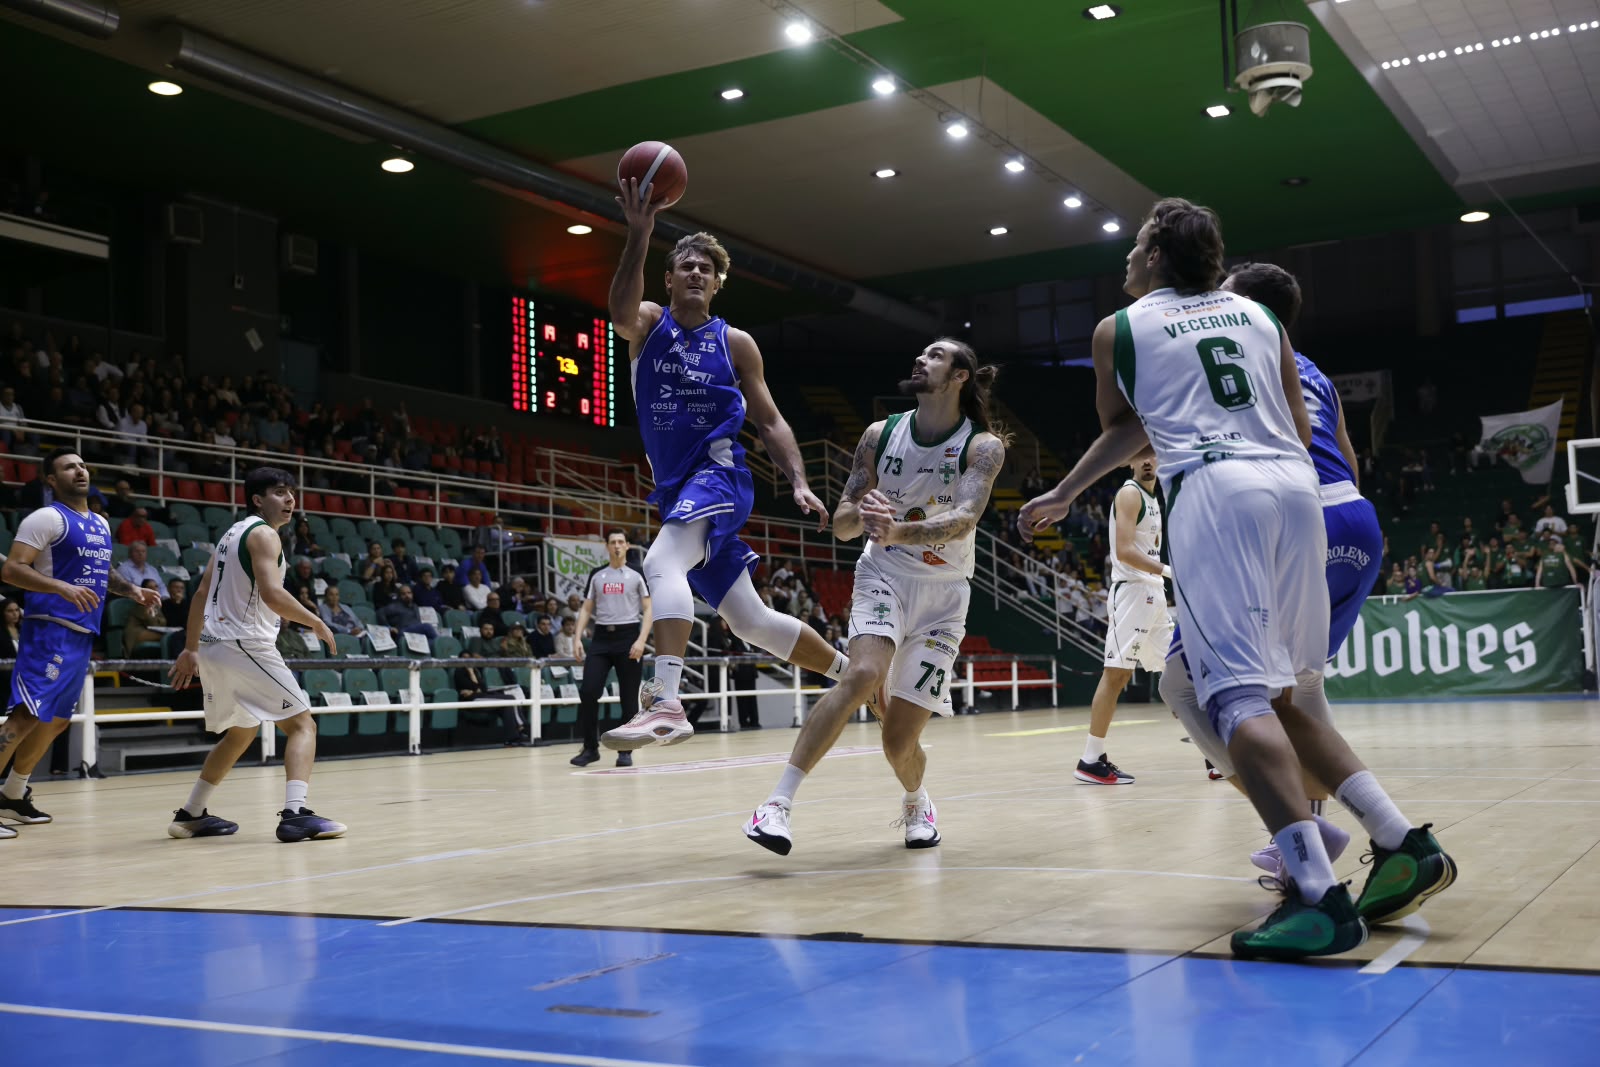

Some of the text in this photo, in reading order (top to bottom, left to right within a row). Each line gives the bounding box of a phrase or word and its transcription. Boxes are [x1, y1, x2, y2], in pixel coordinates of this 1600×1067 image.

[1181, 296, 1234, 311] Duferco
[1185, 305, 1222, 315] Energia
[1163, 312, 1253, 339] VECERINA
[698, 341, 717, 353] 15
[1195, 336, 1258, 413] 6
[546, 391, 556, 408] 2
[884, 455, 903, 476] 73
[670, 499, 696, 514] 15
[937, 495, 953, 503] SIA
[914, 660, 946, 700] 73
